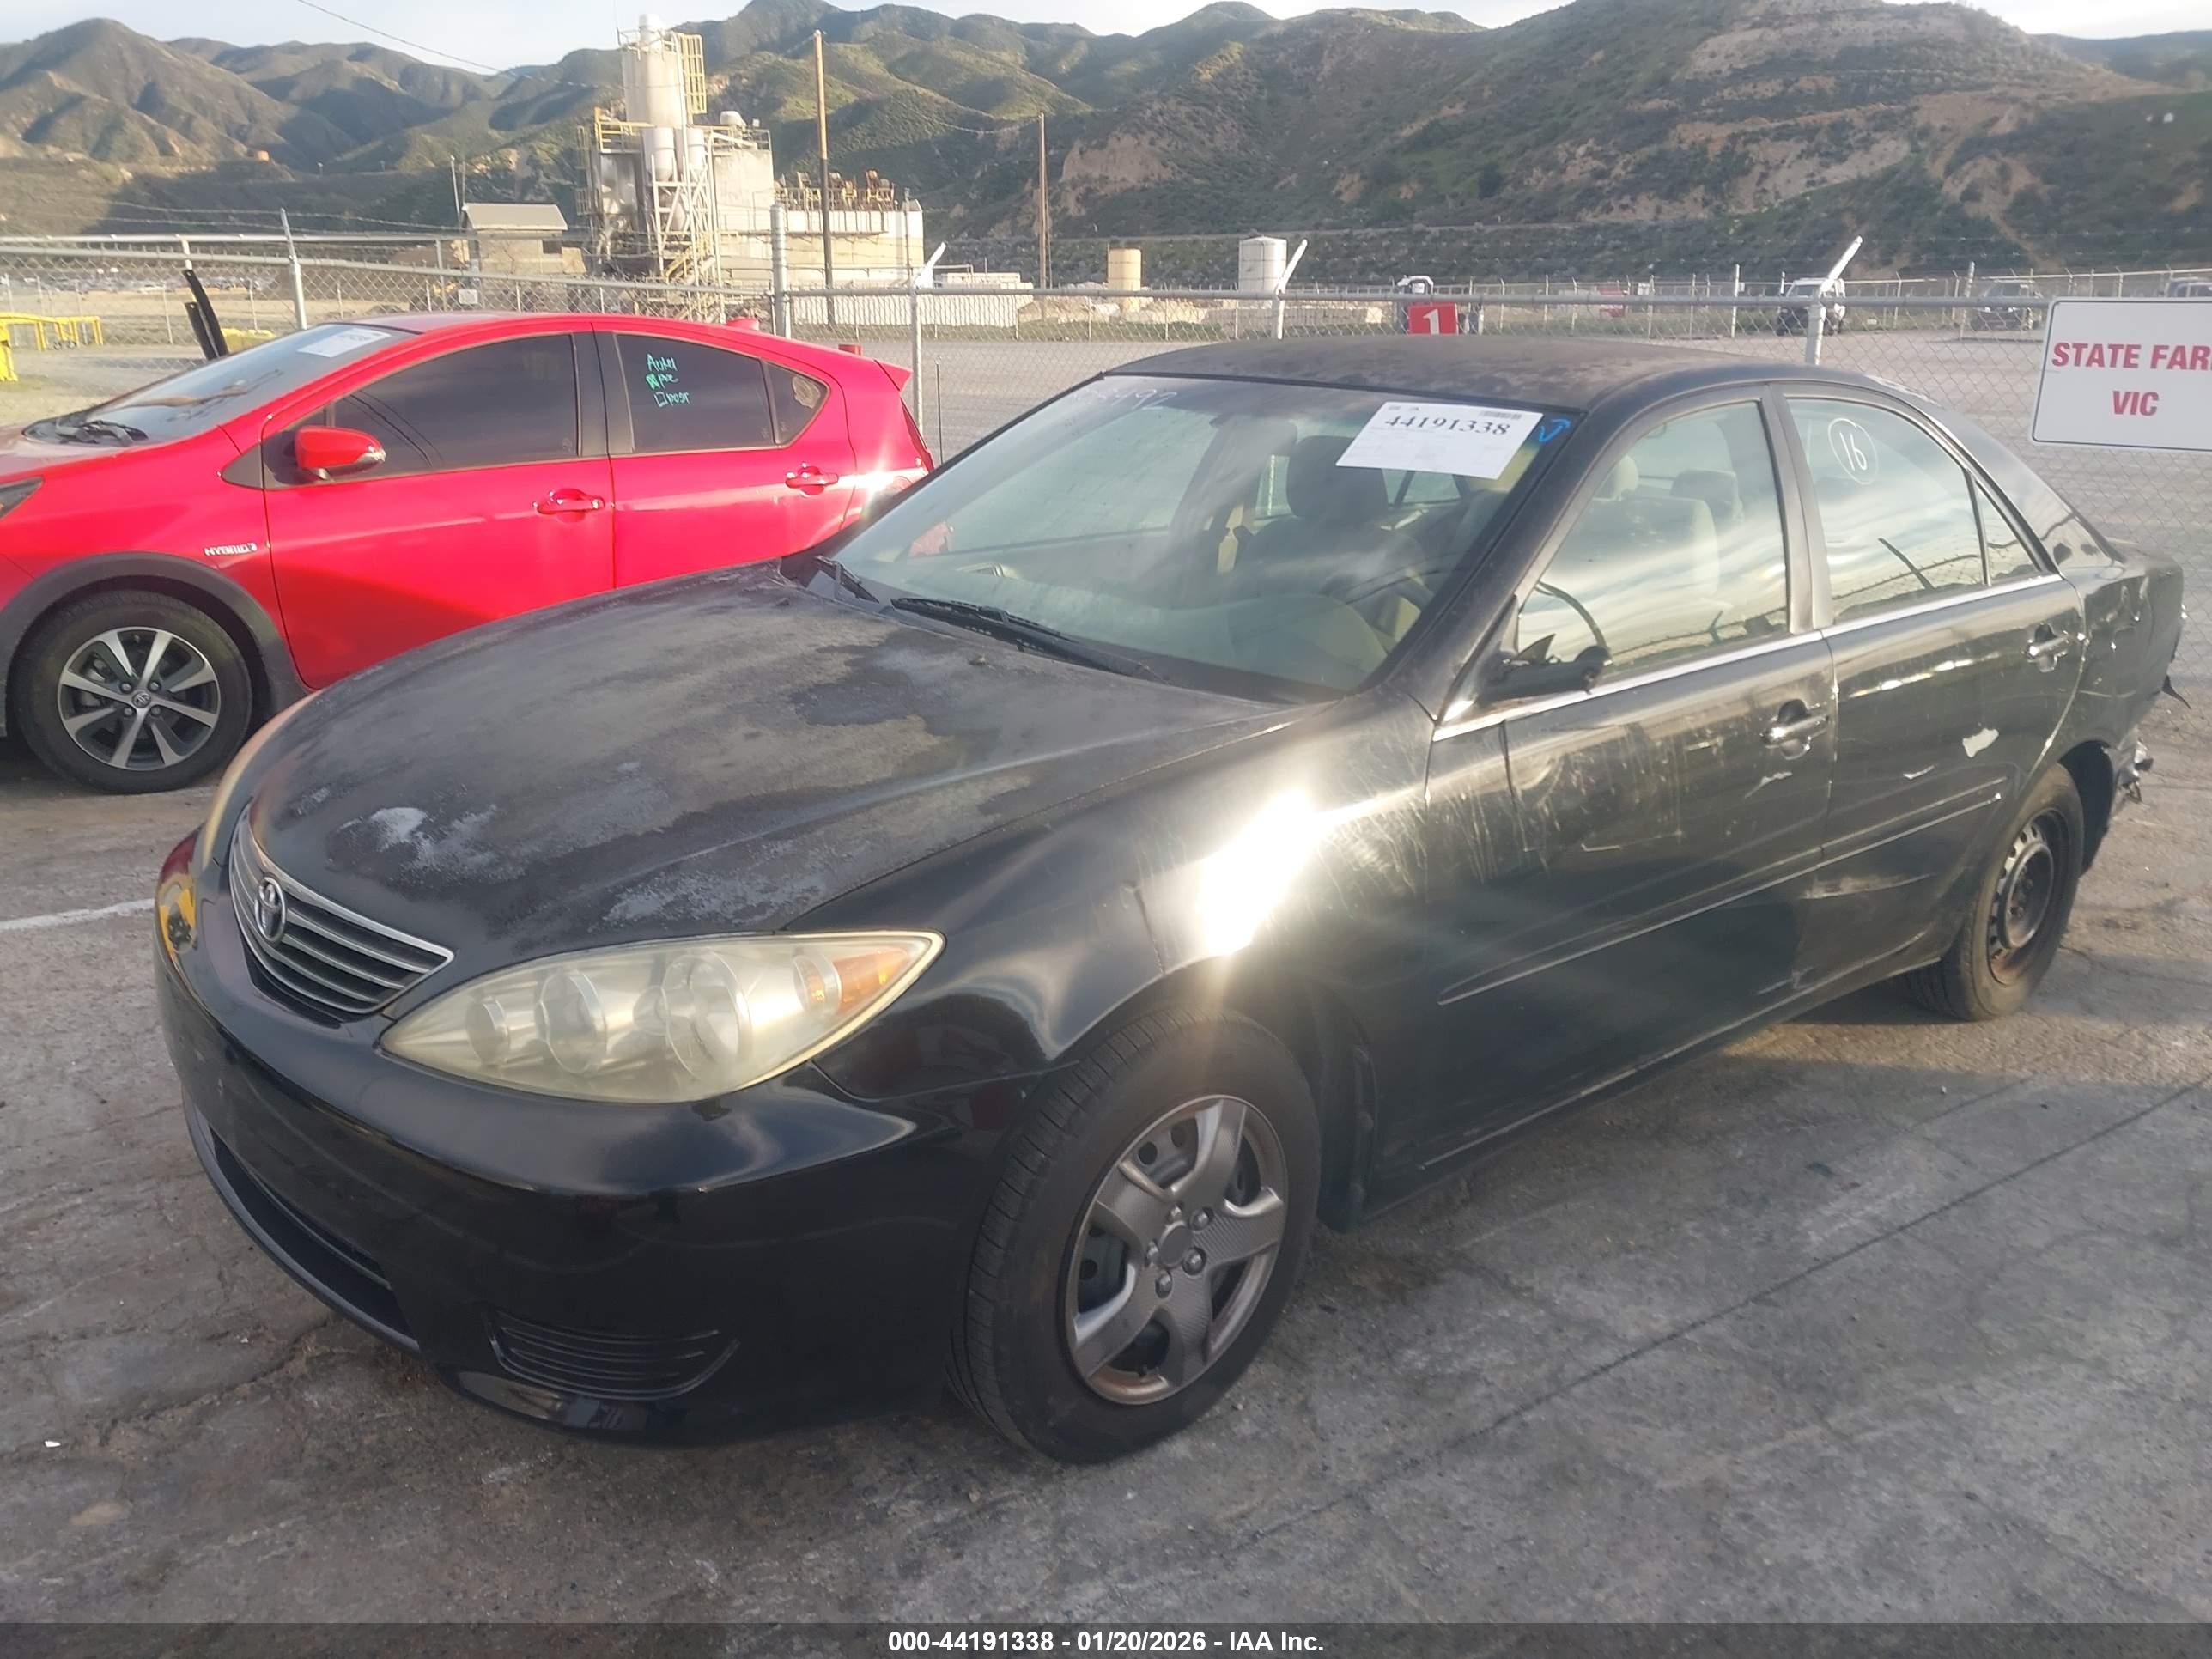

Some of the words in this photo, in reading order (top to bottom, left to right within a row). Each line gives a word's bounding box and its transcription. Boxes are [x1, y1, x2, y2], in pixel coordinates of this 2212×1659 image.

[1423, 308, 1440, 336] 1
[2051, 342, 2142, 369] STATE
[2149, 345, 2212, 371] FAR
[2112, 391, 2160, 416] VIC
[1384, 415, 1510, 436] 44191338
[1838, 431, 1868, 471] 16
